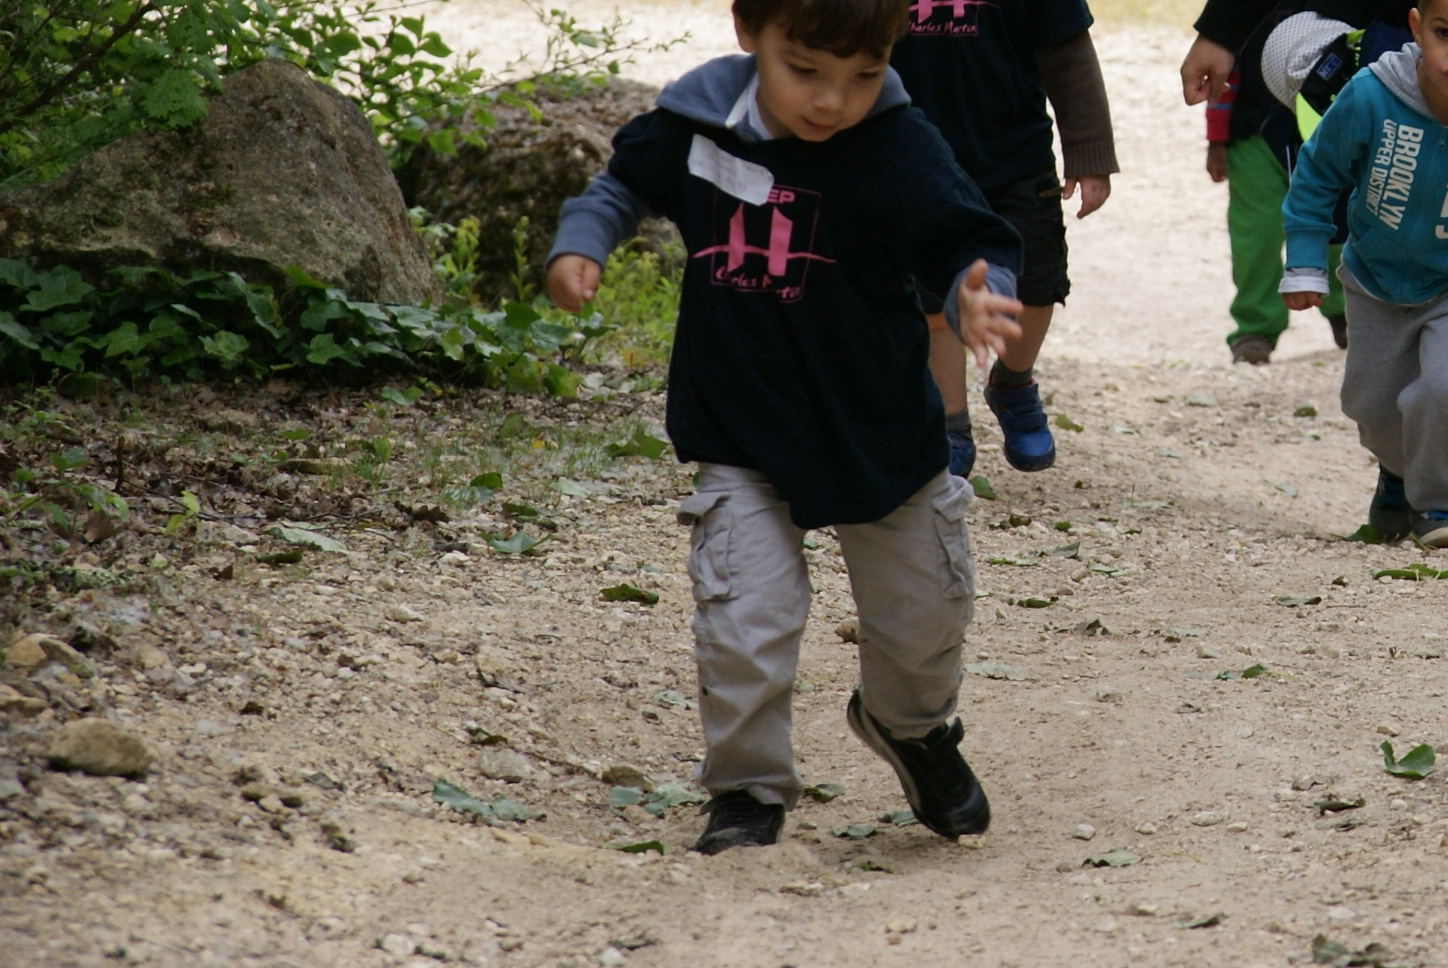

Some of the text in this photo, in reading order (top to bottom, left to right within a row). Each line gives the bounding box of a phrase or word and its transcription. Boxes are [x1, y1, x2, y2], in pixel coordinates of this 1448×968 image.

[908, 21, 976, 35] harles Martin
[1366, 118, 1397, 217] UPPER DISTRICT
[1379, 124, 1424, 230] BROOKLYN
[766, 189, 796, 205] EP
